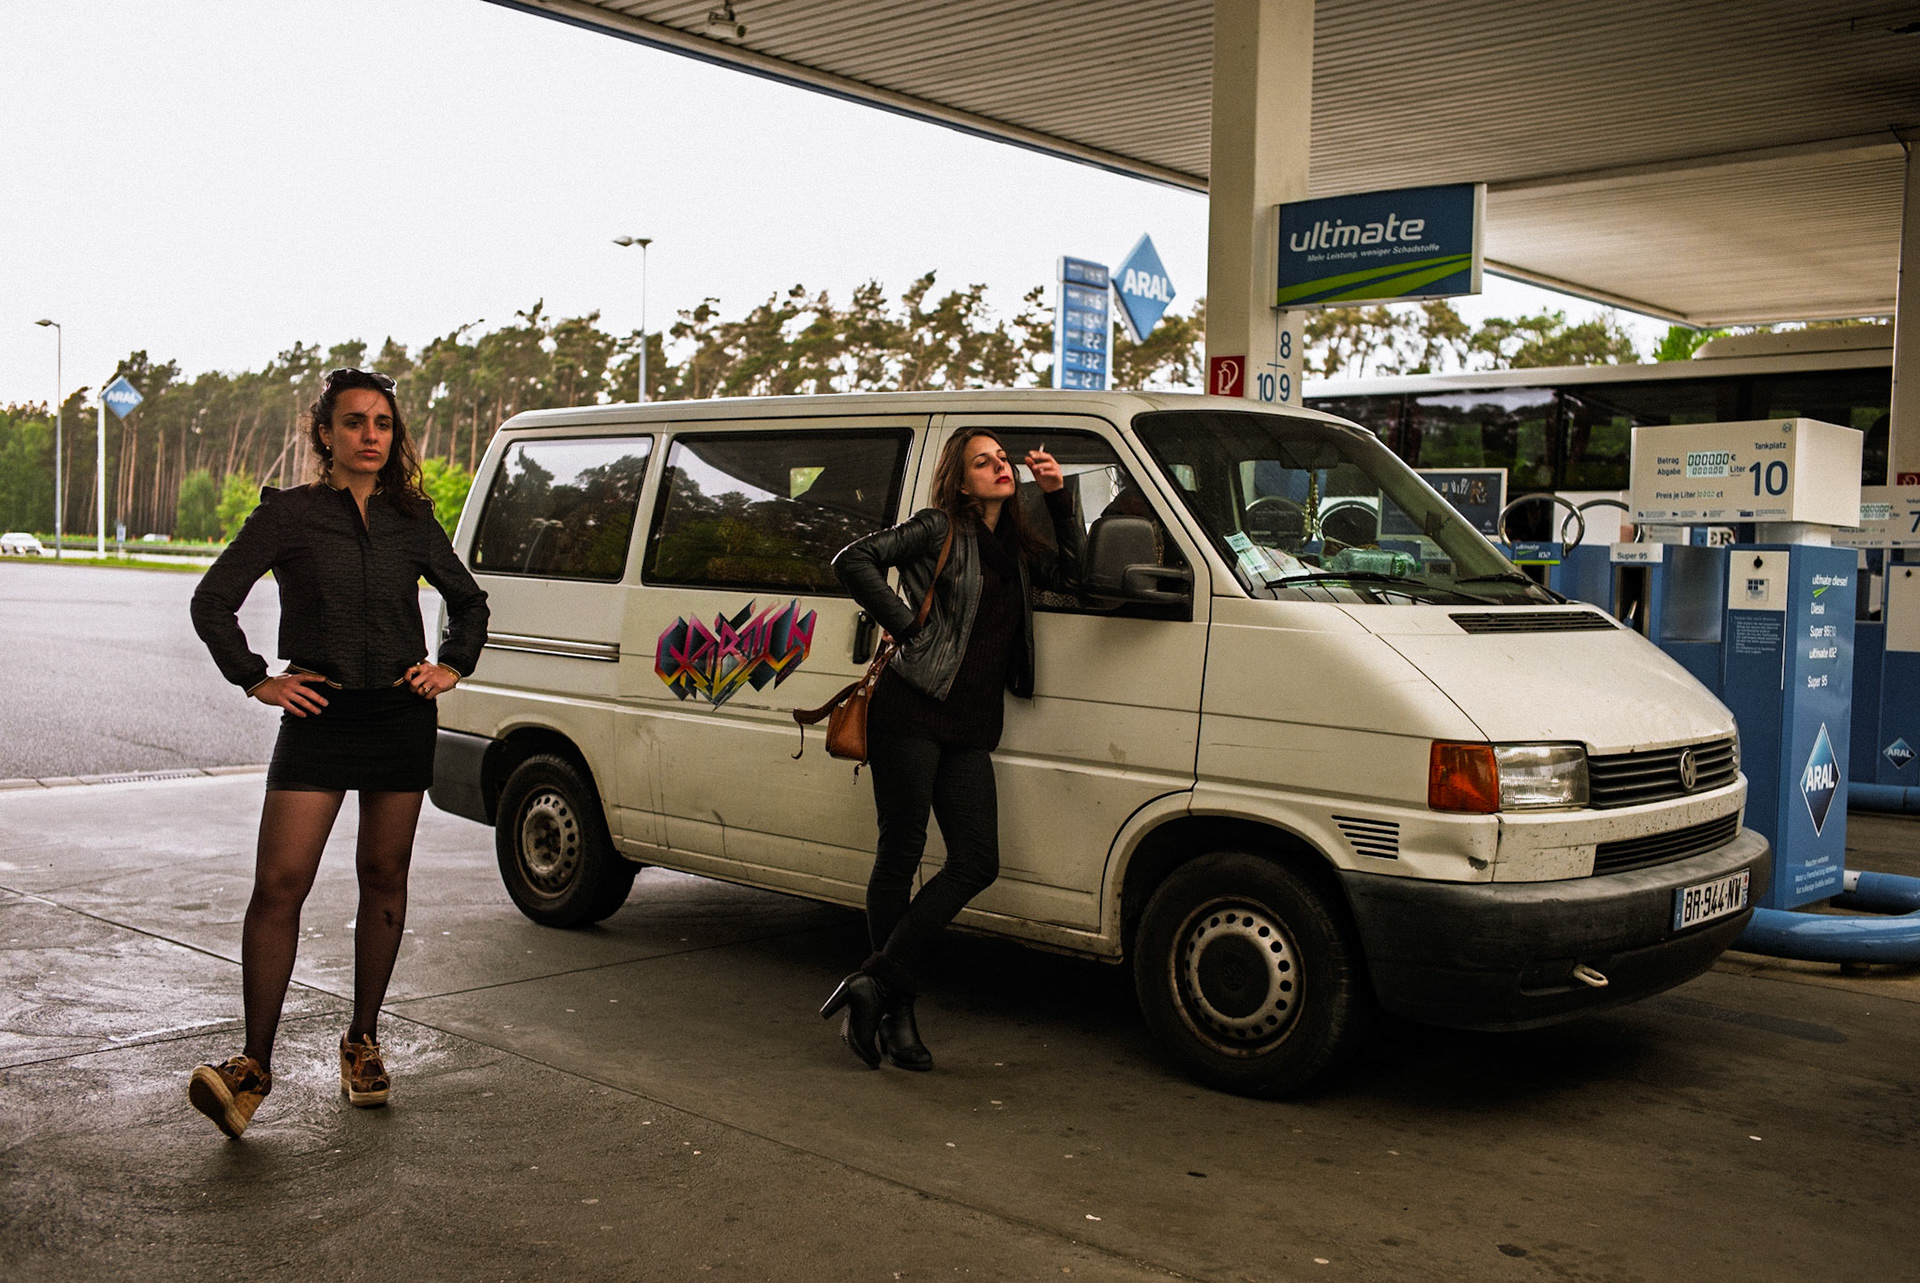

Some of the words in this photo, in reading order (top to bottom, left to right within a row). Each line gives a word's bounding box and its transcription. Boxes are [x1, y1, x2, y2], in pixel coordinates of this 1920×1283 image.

[1290, 212, 1425, 252] ultimate
[1307, 253, 1325, 261] Mehr
[1361, 247, 1390, 257] weniger
[1392, 243, 1440, 254] Schadstoffe
[1122, 268, 1171, 303] ARAL
[1280, 331, 1291, 359] 8
[1257, 372, 1274, 402] 10
[1280, 374, 1290, 402] 9
[1755, 442, 1787, 450] Tankplatz
[1657, 457, 1679, 465] Betrag
[1657, 468, 1681, 476] Abgabe
[1749, 460, 1788, 496] 10
[1909, 511, 1920, 533] 7
[1617, 552, 1636, 560] Super
[1812, 574, 1831, 585] ultimate
[1832, 575, 1848, 586] diesel
[1811, 602, 1825, 614] Diesel
[1810, 625, 1823, 639] Super
[1808, 675, 1821, 689] Super
[1821, 675, 1828, 686] 95
[1887, 749, 1912, 757] ARAL
[1805, 763, 1835, 793] ARAL
